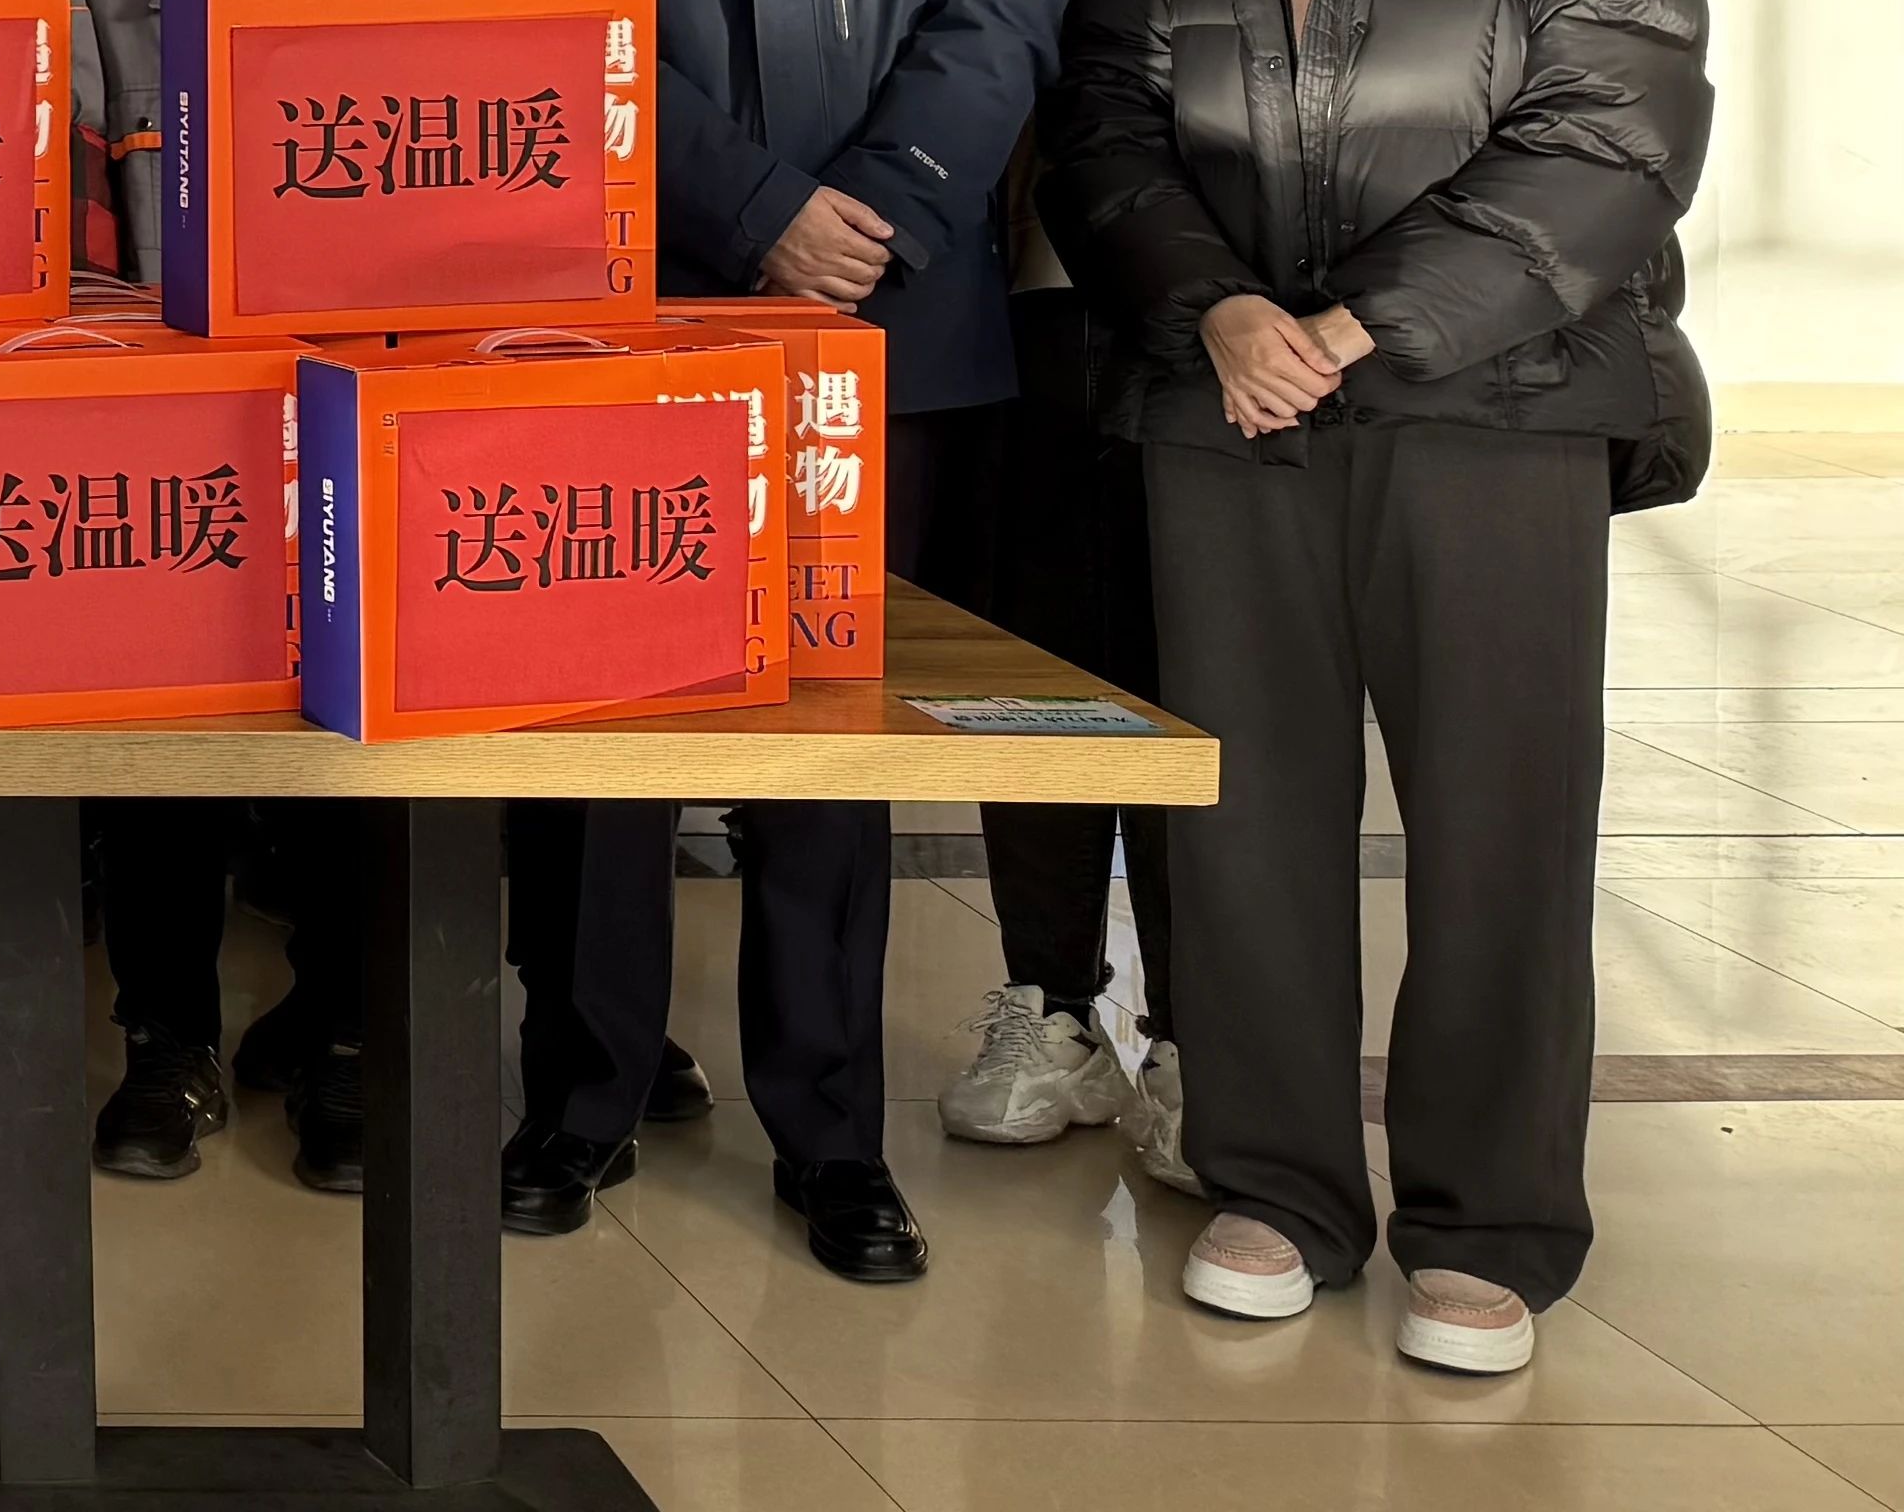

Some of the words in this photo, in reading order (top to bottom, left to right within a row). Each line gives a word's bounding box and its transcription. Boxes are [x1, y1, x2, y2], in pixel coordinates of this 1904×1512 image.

[272, 89, 571, 200] 送温暖
[795, 371, 863, 516] 遇物
[322, 477, 335, 603] SIYUTANG
[433, 475, 718, 593] 送温暖
